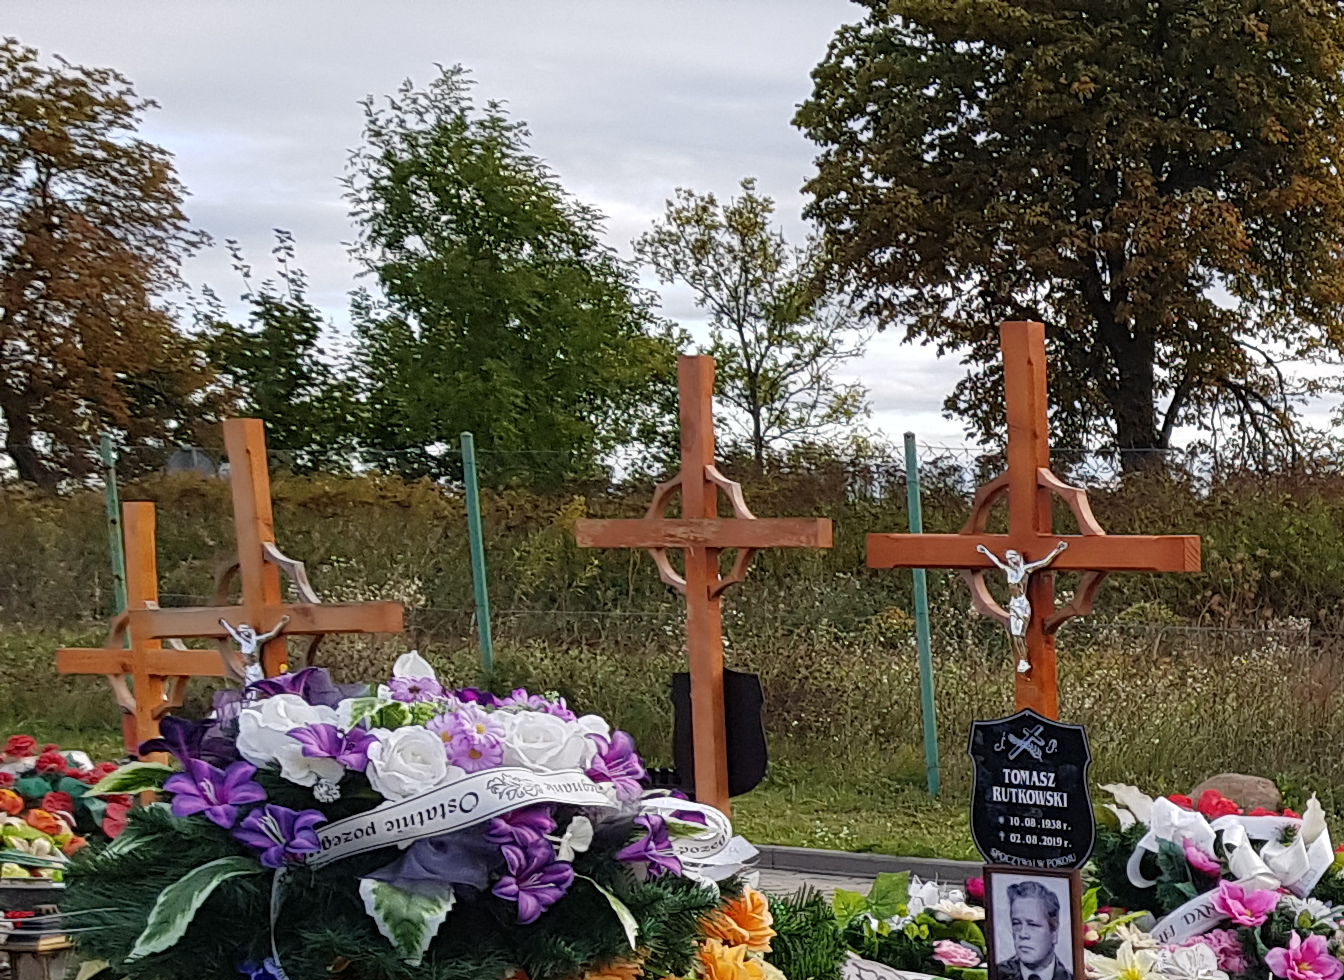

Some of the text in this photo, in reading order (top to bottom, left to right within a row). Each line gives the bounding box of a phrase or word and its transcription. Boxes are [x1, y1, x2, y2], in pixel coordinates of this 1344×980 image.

[1003, 768, 1056, 787] TOMASZ
[992, 786, 1068, 808] RUTKOWSKI
[385, 792, 480, 833] Ostatnie
